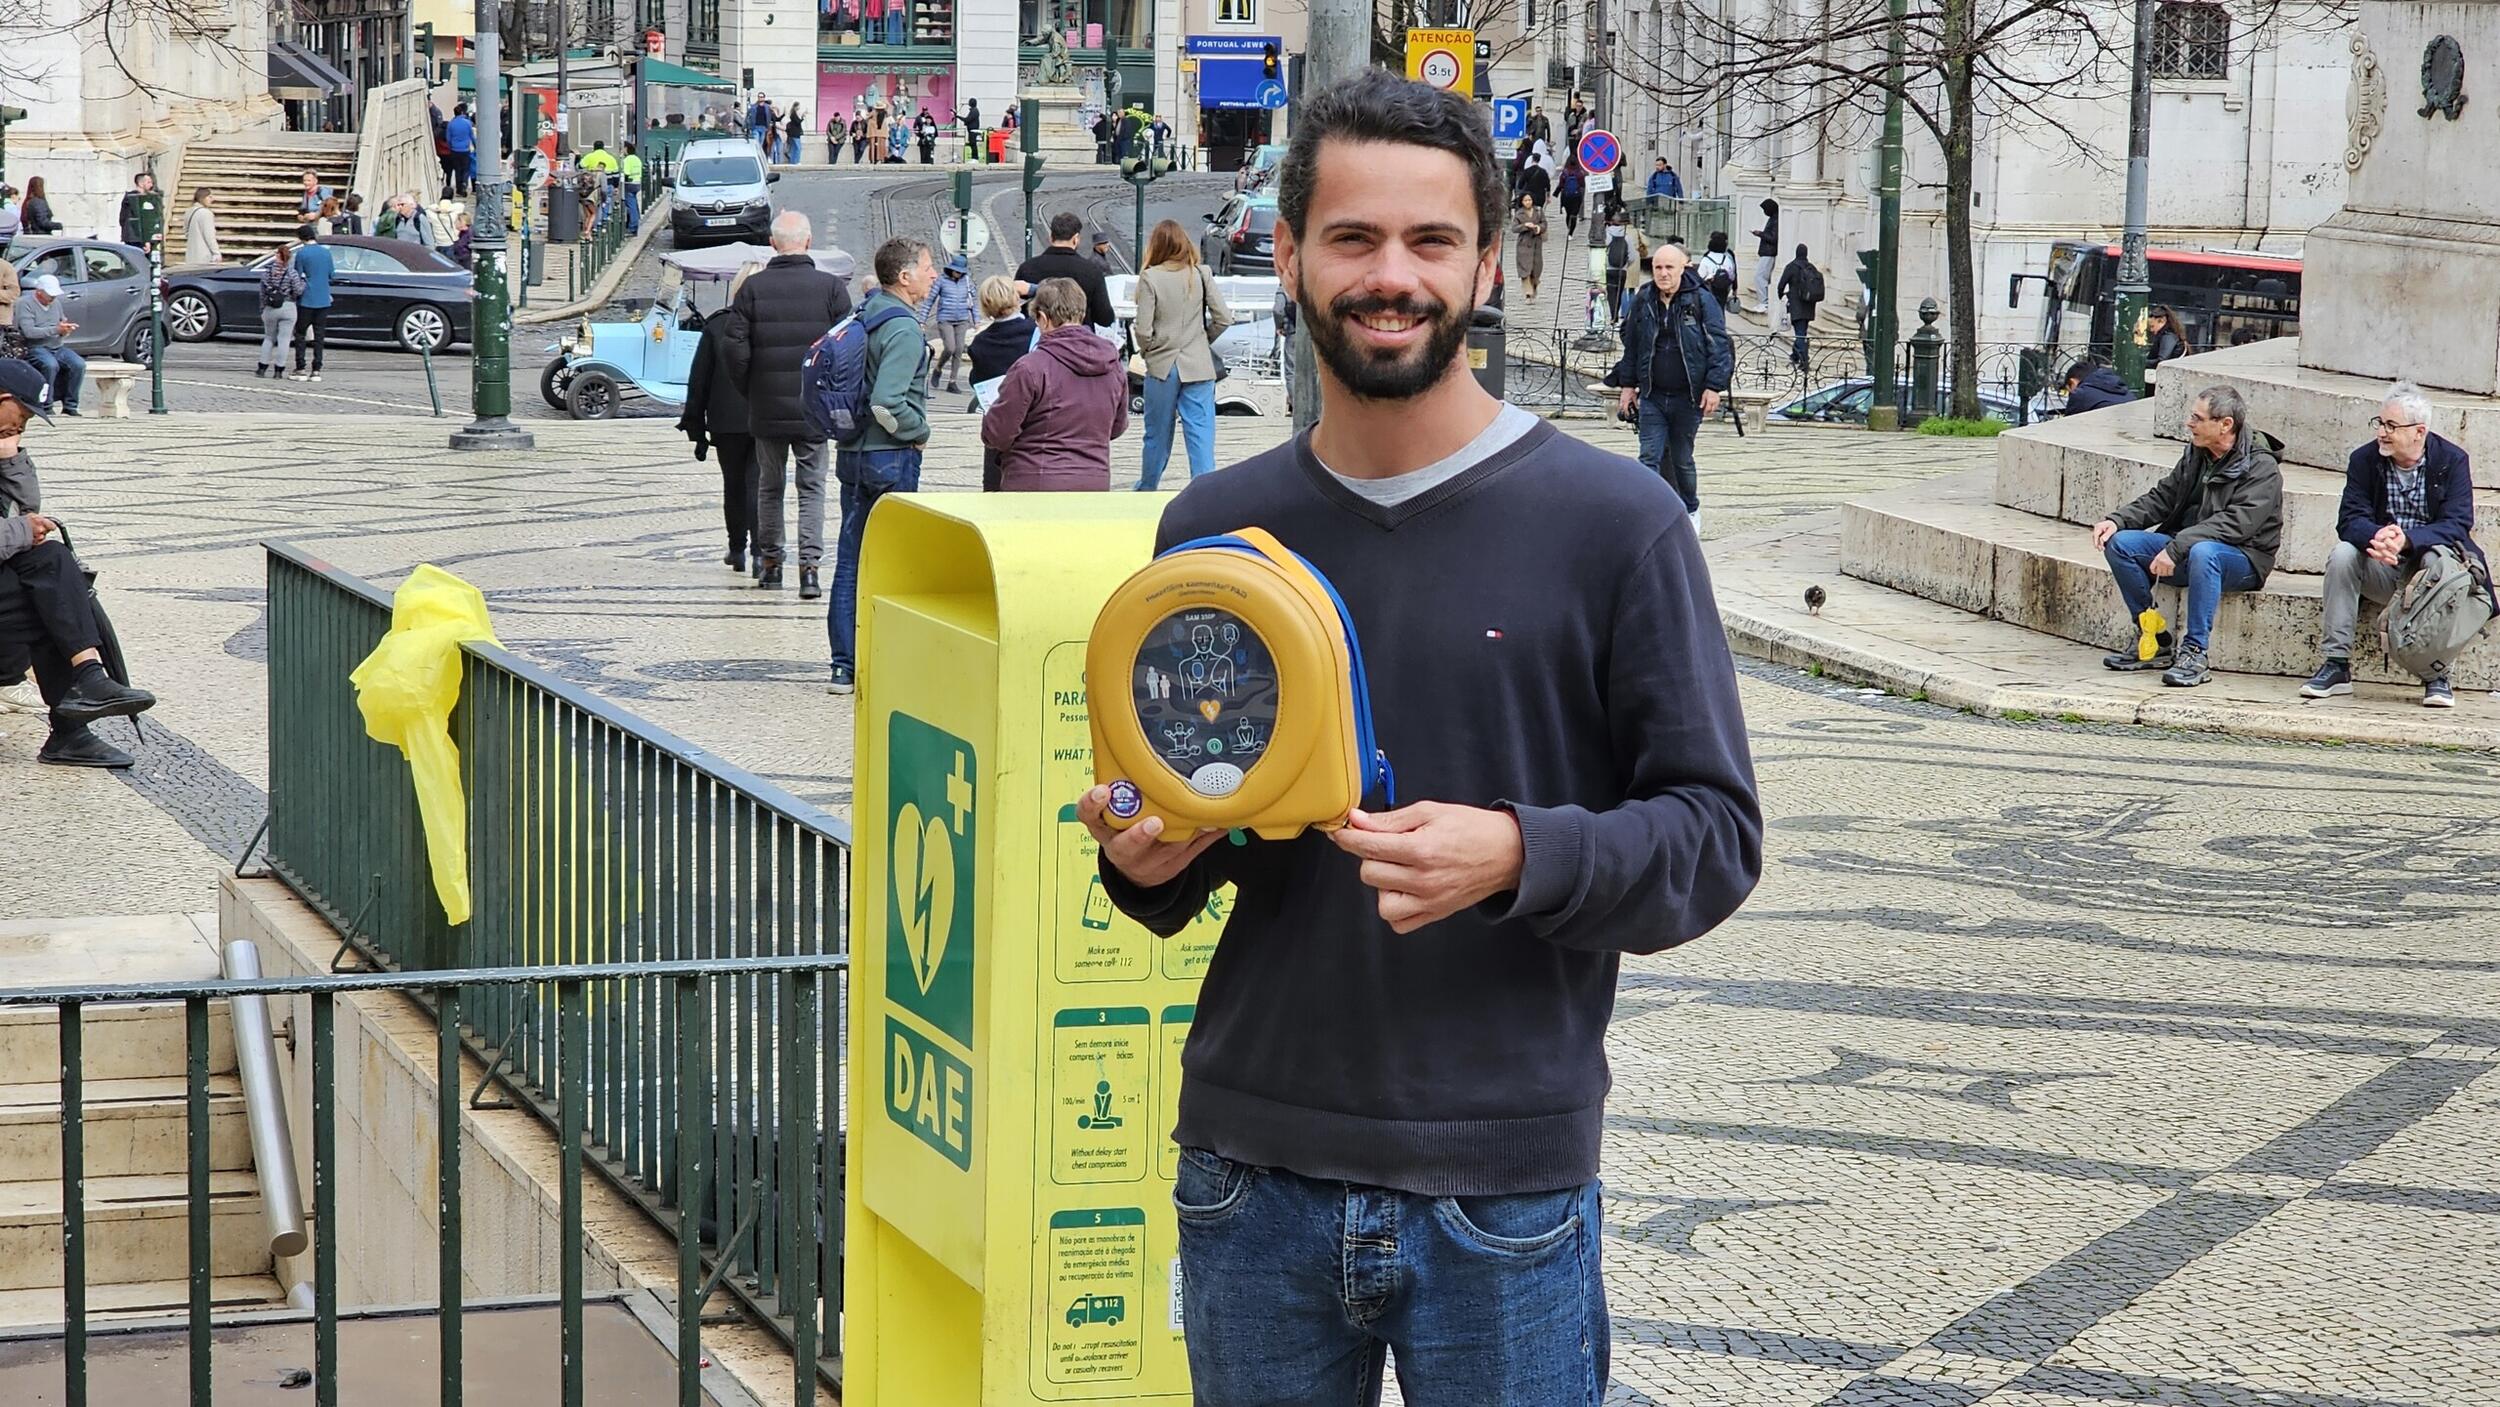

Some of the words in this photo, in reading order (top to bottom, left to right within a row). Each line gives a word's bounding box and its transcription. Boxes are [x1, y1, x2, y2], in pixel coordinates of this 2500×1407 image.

[1410, 32, 1472, 45] ATENÇÃO
[823, 64, 854, 75] UNITED
[856, 65, 890, 75] COLORS
[1428, 64, 1451, 77] 3.5t
[1500, 105, 1519, 132] P
[1054, 749, 1083, 761] WHAT
[1093, 896, 1109, 909] 112
[1087, 945, 1105, 955] Make
[1120, 957, 1134, 967] 112
[1098, 1012, 1106, 1023] 3
[1074, 1040, 1088, 1049] Sem
[893, 1036, 964, 1153] DAE
[1122, 1095, 1127, 1104] 5
[1071, 1147, 1094, 1157] Without
[1095, 1146, 1112, 1157] delay
[1072, 1161, 1087, 1169] chest
[1094, 1213, 1102, 1224] 5
[1059, 1236, 1072, 1245] Não
[1073, 1237, 1087, 1246] pare
[1127, 1232, 1136, 1242] de
[1104, 1299, 1119, 1308] 112
[1052, 1342, 1061, 1351] Do
